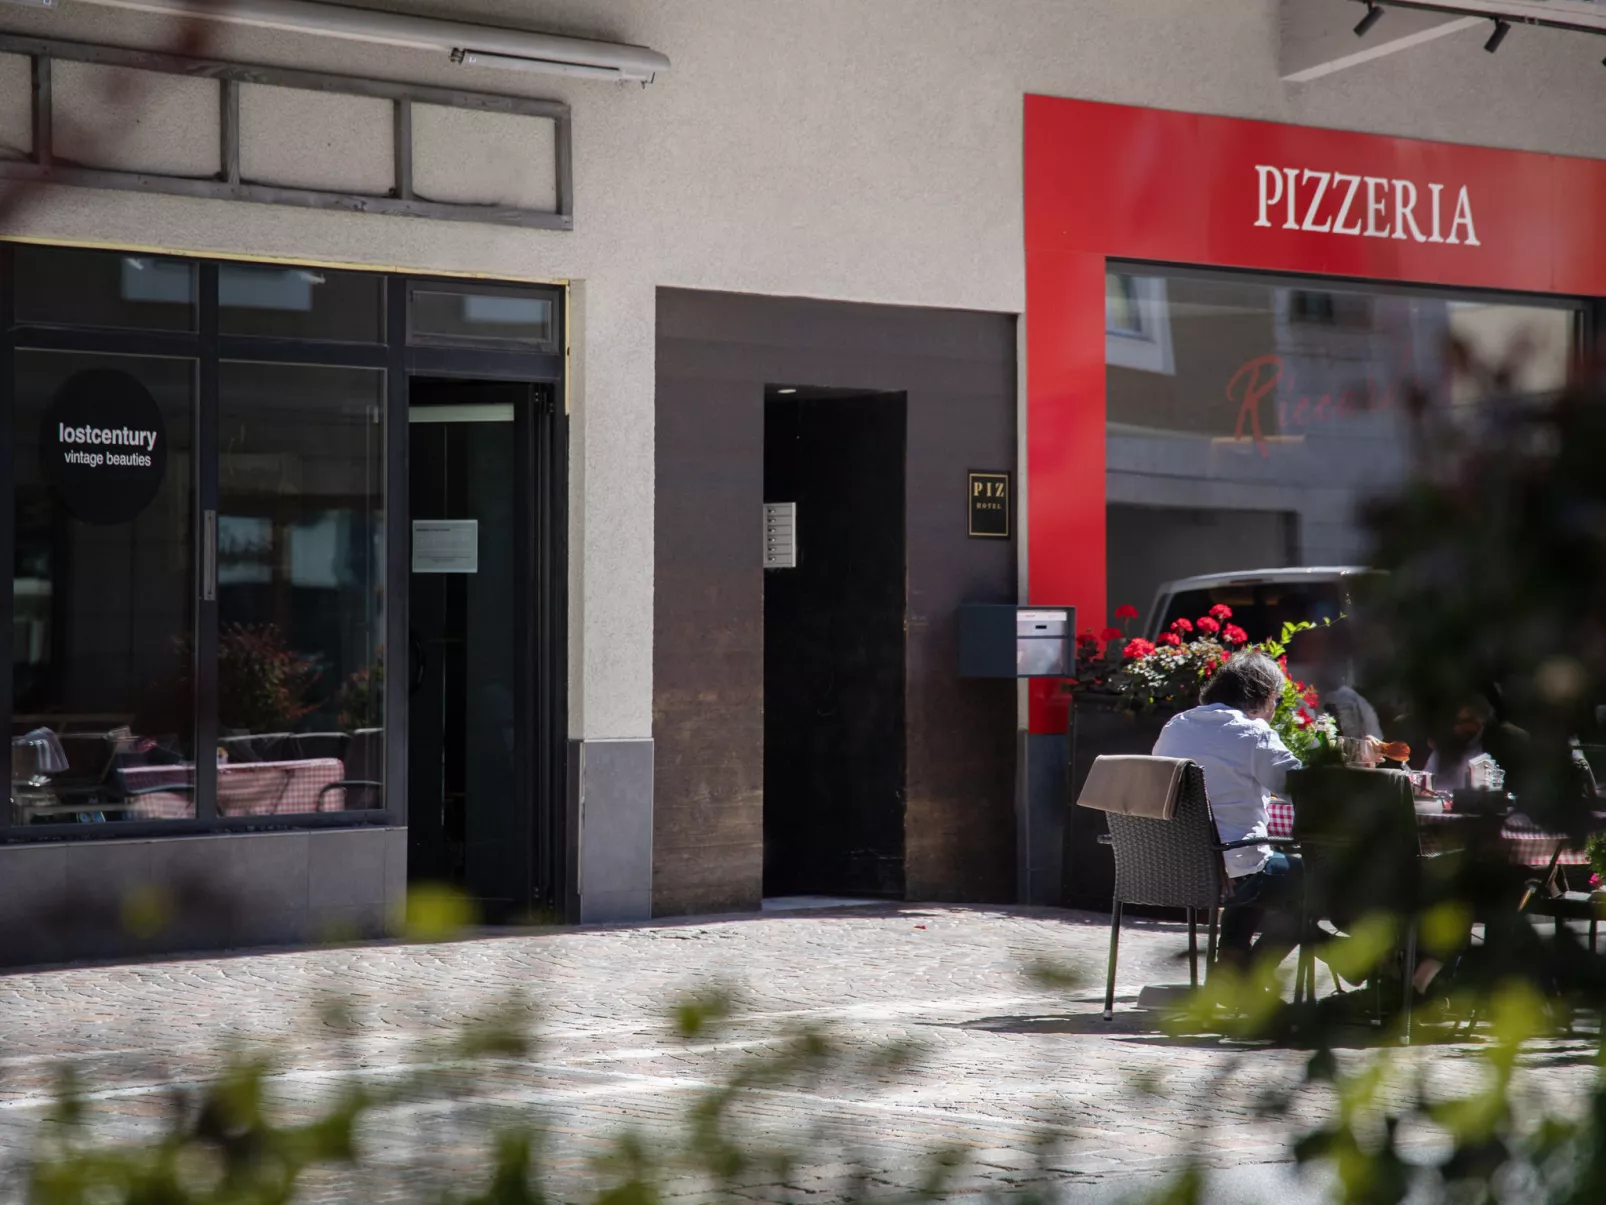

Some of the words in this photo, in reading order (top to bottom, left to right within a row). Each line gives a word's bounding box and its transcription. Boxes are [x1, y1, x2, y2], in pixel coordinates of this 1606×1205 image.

[1253, 164, 1481, 246] PIZZERIA
[59, 422, 157, 451] lostcentury
[64, 450, 104, 467] vintage
[106, 452, 152, 466] beauties
[973, 482, 1005, 497] PIZ
